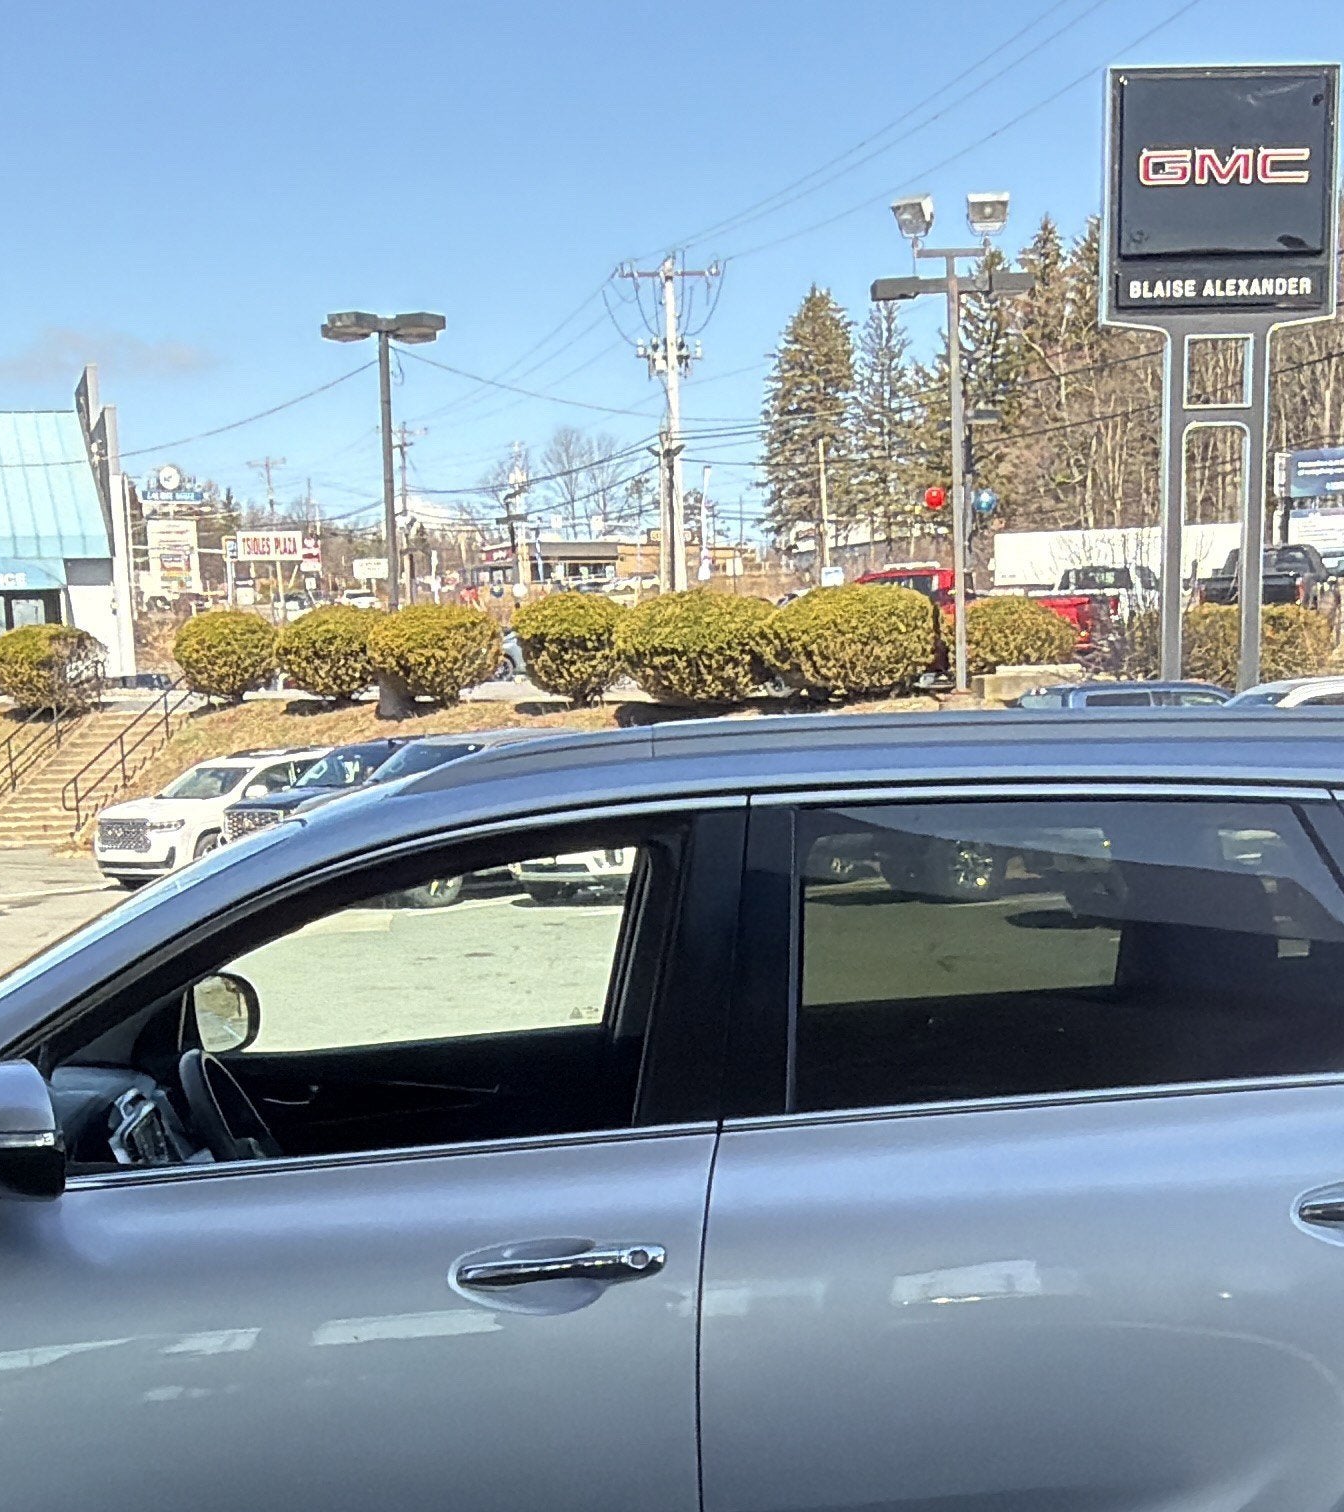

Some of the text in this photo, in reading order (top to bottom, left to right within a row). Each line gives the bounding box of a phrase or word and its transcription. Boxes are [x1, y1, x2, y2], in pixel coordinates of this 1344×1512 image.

[1139, 147, 1310, 185] GMC
[1129, 276, 1312, 299] BLAISE ALEXANDER
